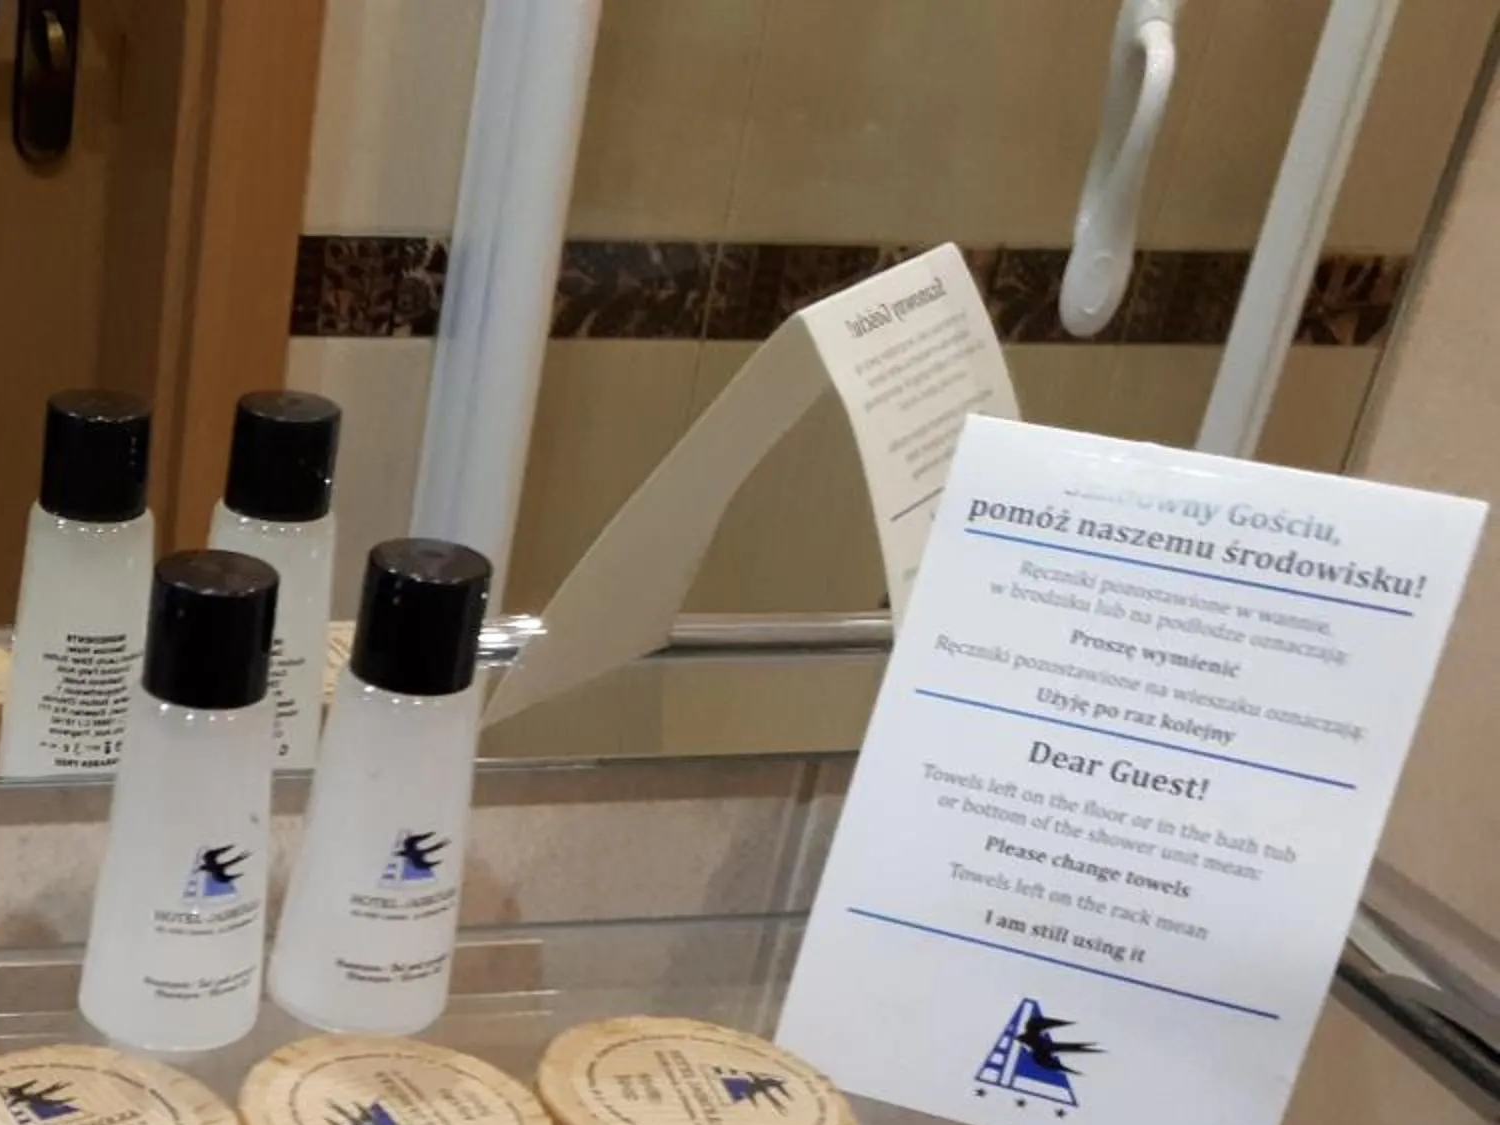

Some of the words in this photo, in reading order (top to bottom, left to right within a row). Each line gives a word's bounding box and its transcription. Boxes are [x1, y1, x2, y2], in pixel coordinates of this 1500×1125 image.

[967, 498, 1072, 533] pomóż
[1076, 517, 1216, 561] naszemu
[1221, 539, 1428, 599] środowisku!
[1228, 502, 1341, 547] Gościu,
[990, 581, 1006, 595] w
[1094, 598, 1126, 619] lub
[1130, 607, 1153, 625] na
[1236, 605, 1252, 620] w
[934, 633, 1010, 664] Ręczniki
[1145, 683, 1169, 698] na
[1069, 628, 1138, 660] Proszę
[1142, 647, 1242, 679] wymienić
[1035, 686, 1091, 716] Użyję
[1092, 700, 1120, 720] po
[1123, 706, 1157, 728] raz
[1159, 713, 1237, 746] kolejny
[1028, 740, 1104, 778] Dear
[1108, 759, 1212, 801] Guest!
[922, 762, 985, 791] Towels
[987, 778, 1018, 799] left
[1021, 789, 1045, 805] on
[1049, 793, 1080, 814] the
[1083, 799, 1129, 825] floor
[1131, 815, 1154, 830] or
[1156, 818, 1176, 836] in
[1179, 822, 1213, 844] the
[1214, 828, 1259, 855] bath
[1262, 843, 1297, 865] tub
[937, 795, 960, 809] or
[962, 796, 1028, 827] bottom
[1030, 814, 1054, 831] of
[1054, 819, 1084, 839] the
[1087, 827, 1157, 856] shower
[1160, 845, 1200, 867] unit
[984, 834, 1048, 865] Please
[1051, 852, 1122, 883] change
[1124, 870, 1192, 900] towels
[949, 861, 1011, 891] Towels
[1013, 877, 1046, 900] left
[1048, 894, 1073, 908] on
[1075, 895, 1108, 915] the
[1109, 904, 1152, 927] rack
[1154, 915, 1210, 942] mean
[984, 908, 994, 926] I
[995, 915, 1027, 934] am
[1030, 922, 1069, 944] still
[1071, 934, 1128, 963] using
[1129, 946, 1147, 964] it
